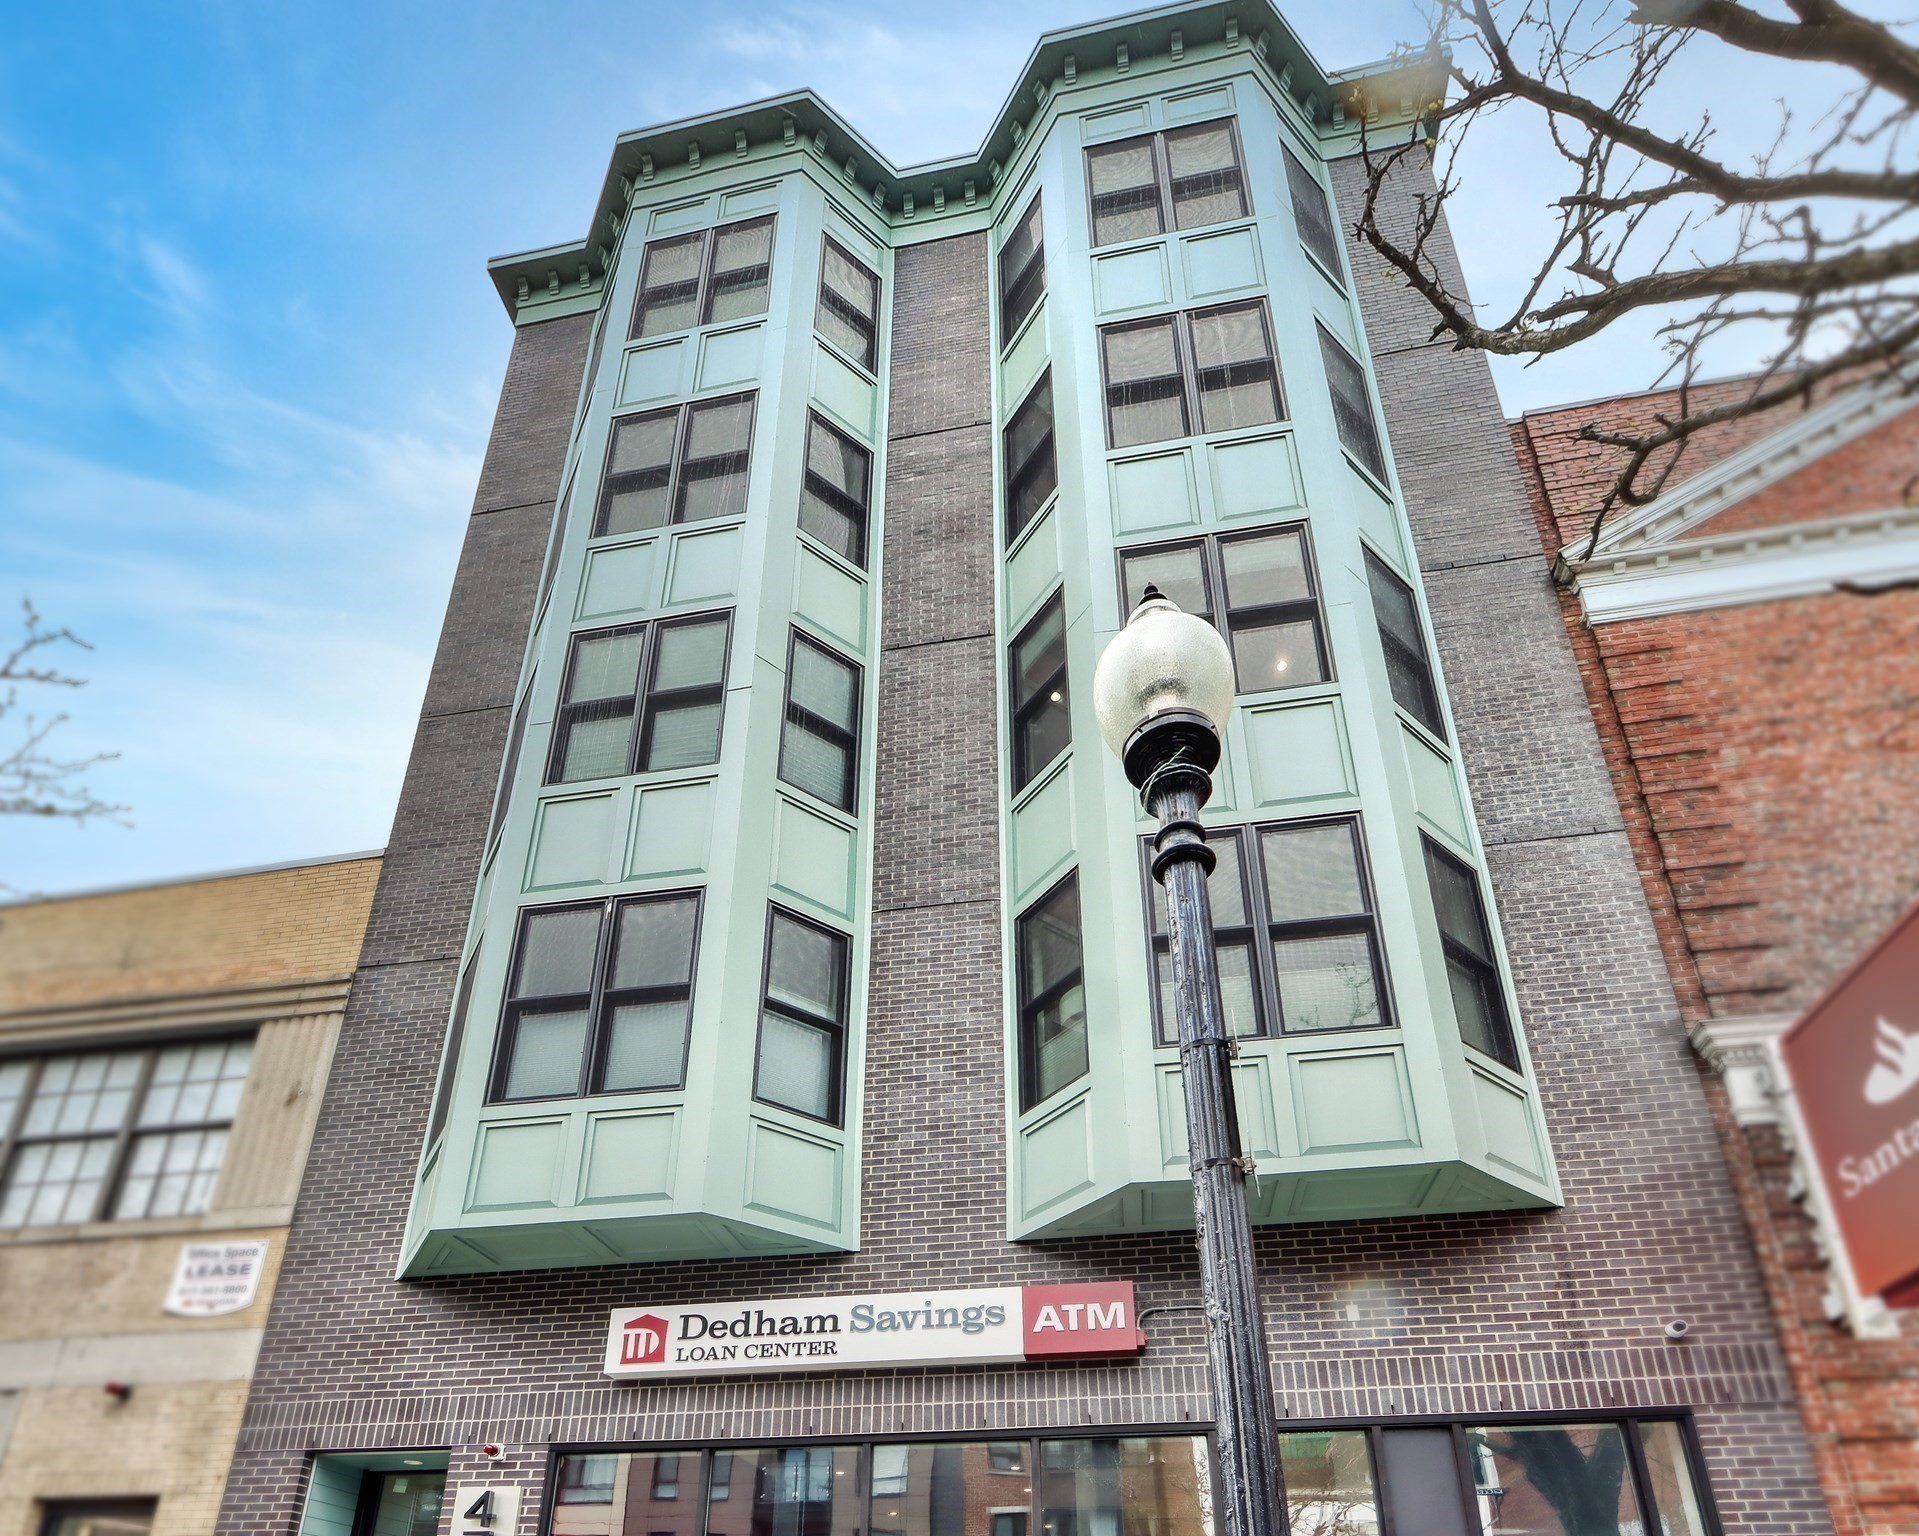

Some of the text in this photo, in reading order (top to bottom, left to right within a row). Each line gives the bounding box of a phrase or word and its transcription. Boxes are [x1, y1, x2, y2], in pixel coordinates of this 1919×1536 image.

[224, 1247, 259, 1260] Space
[184, 1263, 252, 1279] LEASE
[677, 1300, 1006, 1341] Dedham Savings
[1032, 1301, 1126, 1333] ATM
[675, 1340, 838, 1362] LOAN CENTER
[463, 1490, 497, 1528] 4
